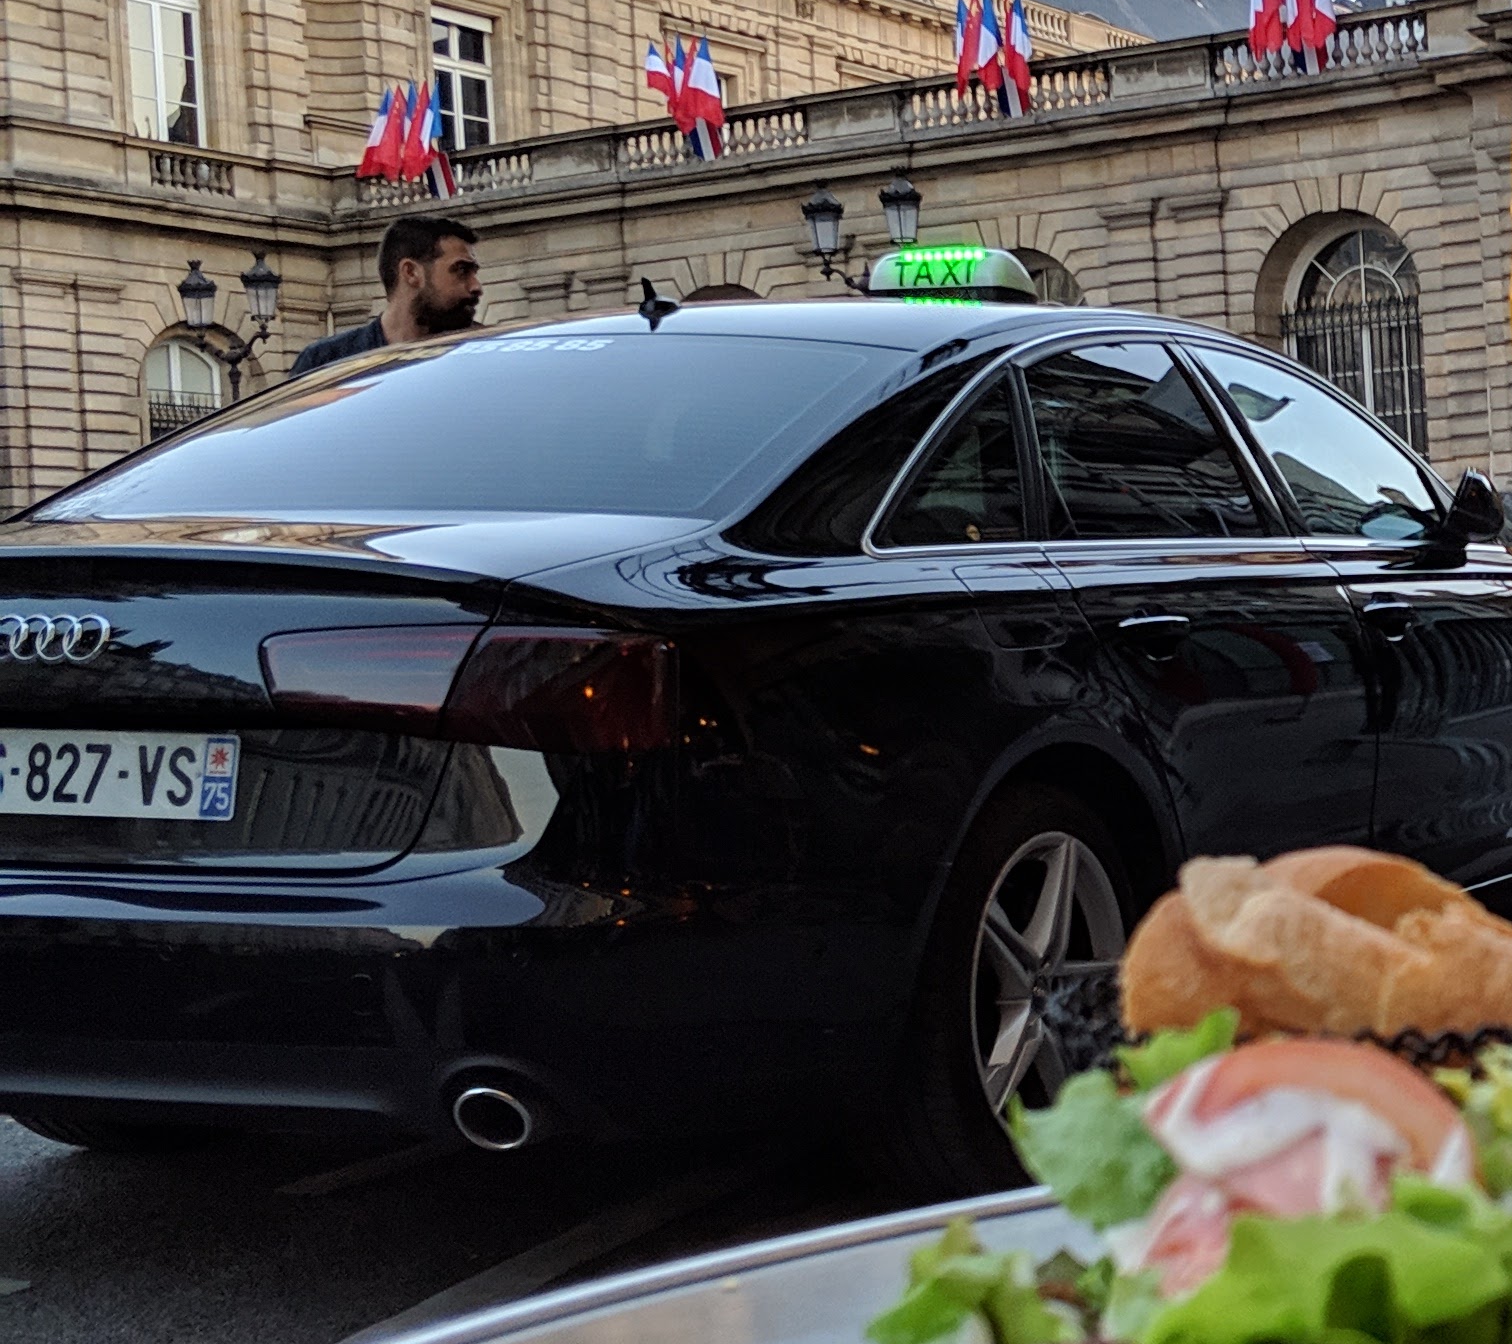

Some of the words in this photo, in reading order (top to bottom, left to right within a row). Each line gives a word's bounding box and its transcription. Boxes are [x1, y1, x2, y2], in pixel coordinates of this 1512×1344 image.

[895, 259, 974, 287] TAXI
[0, 741, 197, 807] -827-VS
[202, 782, 230, 811] 75
